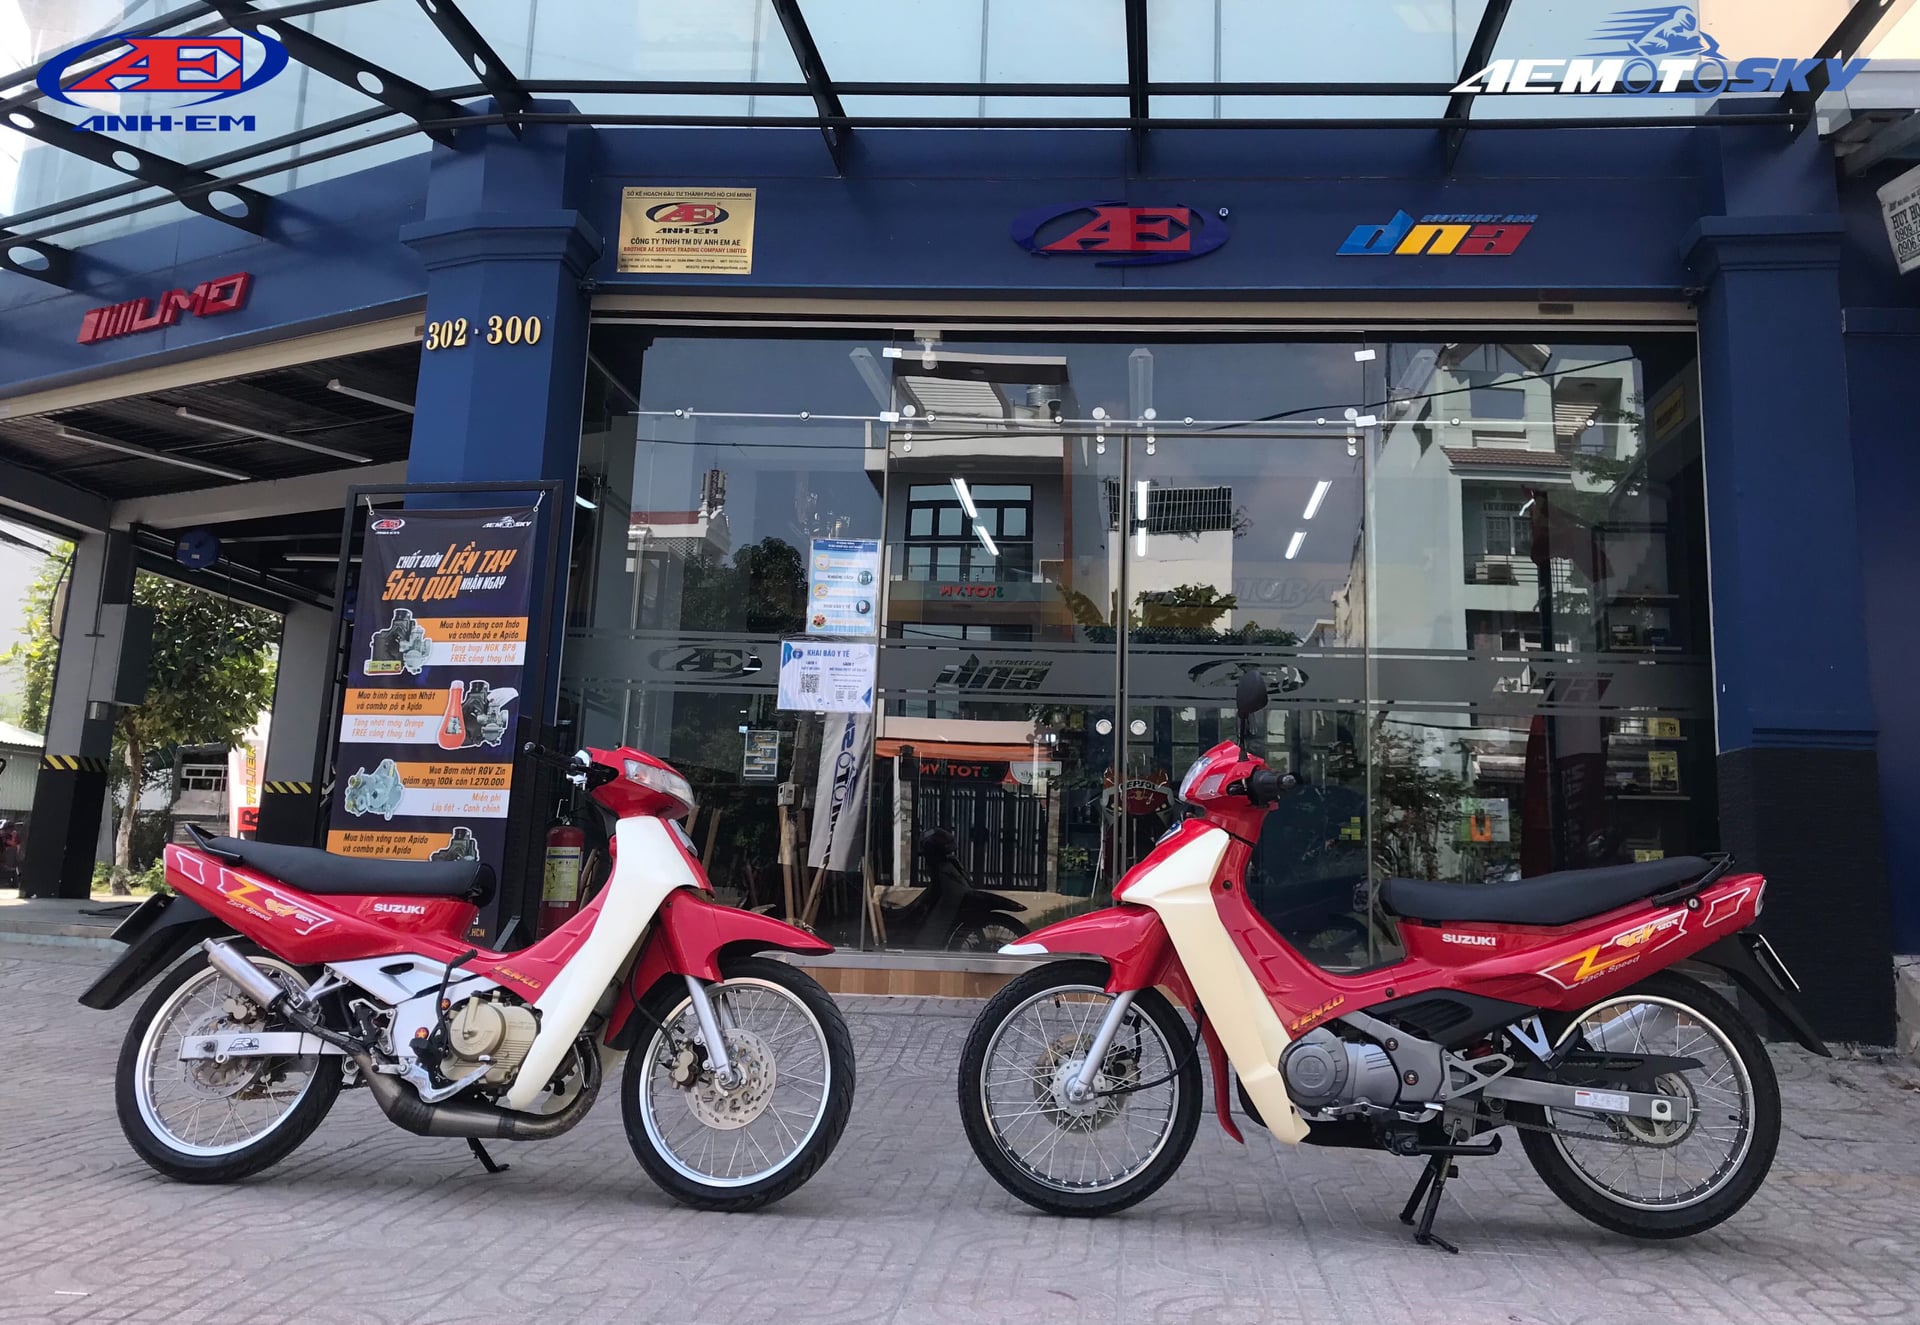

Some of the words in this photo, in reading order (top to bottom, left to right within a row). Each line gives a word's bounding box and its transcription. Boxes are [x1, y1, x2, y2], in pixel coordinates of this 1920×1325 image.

[1891, 208, 1908, 230] HUY
[1041, 207, 1191, 251] AE
[631, 237, 649, 246] CÔNG
[425, 317, 468, 350] 302
[486, 315, 542, 345] 300
[395, 550, 423, 569] CHỐT
[477, 549, 518, 574] TAY
[481, 575, 508, 590] NGAY
[440, 620, 454, 629] Mua
[499, 631, 519, 640] Apido
[450, 654, 466, 662] FREE
[807, 649, 821, 657] KHAI
[366, 702, 387, 710] combo
[352, 729, 367, 737] FREE
[478, 767, 493, 775] RGV
[421, 777, 436, 787] ngay
[437, 777, 453, 785] 100k
[470, 777, 505, 786] 1.270.000
[344, 833, 358, 841] Mua
[408, 835, 429, 845] Apido
[353, 845, 374, 853] combo
[392, 846, 412, 854] Apido
[373, 903, 425, 914] SUZUKI
[1442, 933, 1496, 946] SUZUKI
[1581, 970, 1605, 984] Zack
[1608, 955, 1640, 973] Speed
